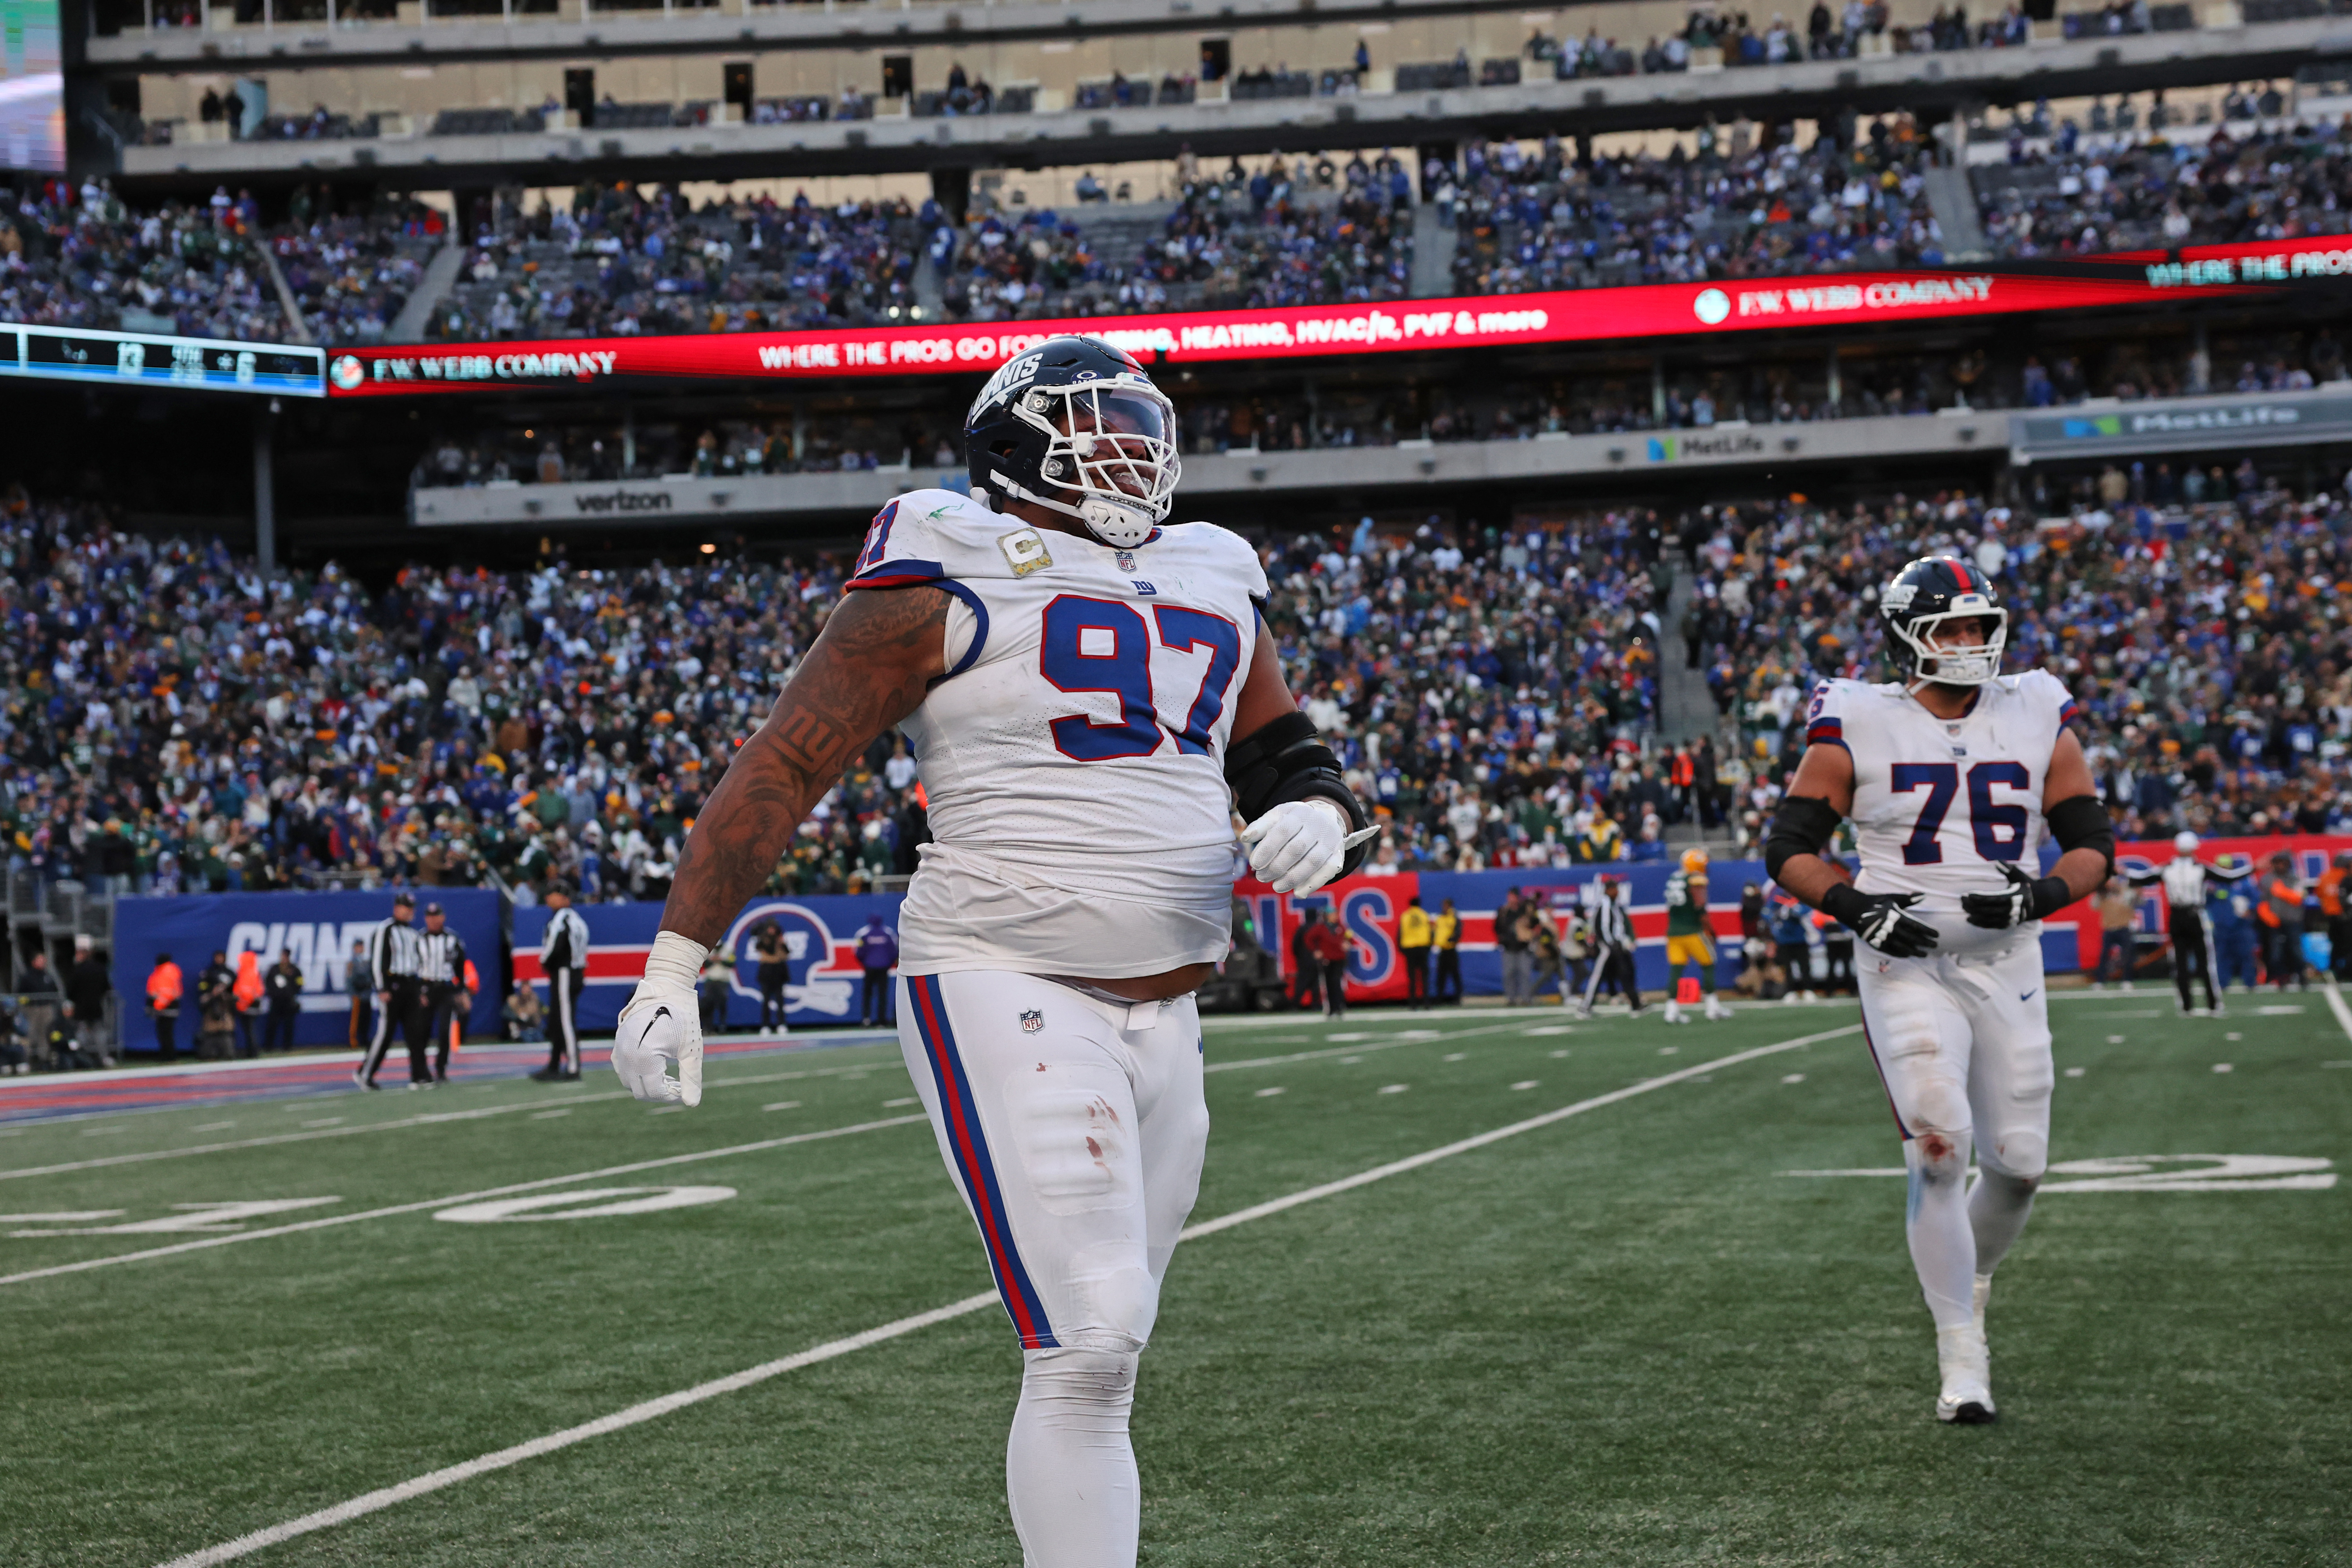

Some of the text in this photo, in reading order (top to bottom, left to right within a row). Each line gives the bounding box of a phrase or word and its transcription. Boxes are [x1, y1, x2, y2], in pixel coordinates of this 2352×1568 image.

[1787, 285, 1863, 312] WEBB
[1865, 275, 1993, 308] COMPANY
[758, 343, 839, 369] WHERE
[844, 341, 887, 366] THE
[891, 339, 953, 364] PROS
[956, 336, 996, 361] GO
[1454, 310, 1477, 335] &
[1478, 309, 1548, 334] more
[420, 356, 493, 380] WEBB
[495, 351, 617, 379] COMPANY
[1002, 528, 1044, 564] C
[1119, 559, 1134, 569] NFL
[1040, 594, 1241, 762] 97
[1891, 761, 2029, 865] 76
[1024, 1019, 1041, 1029] NFL
